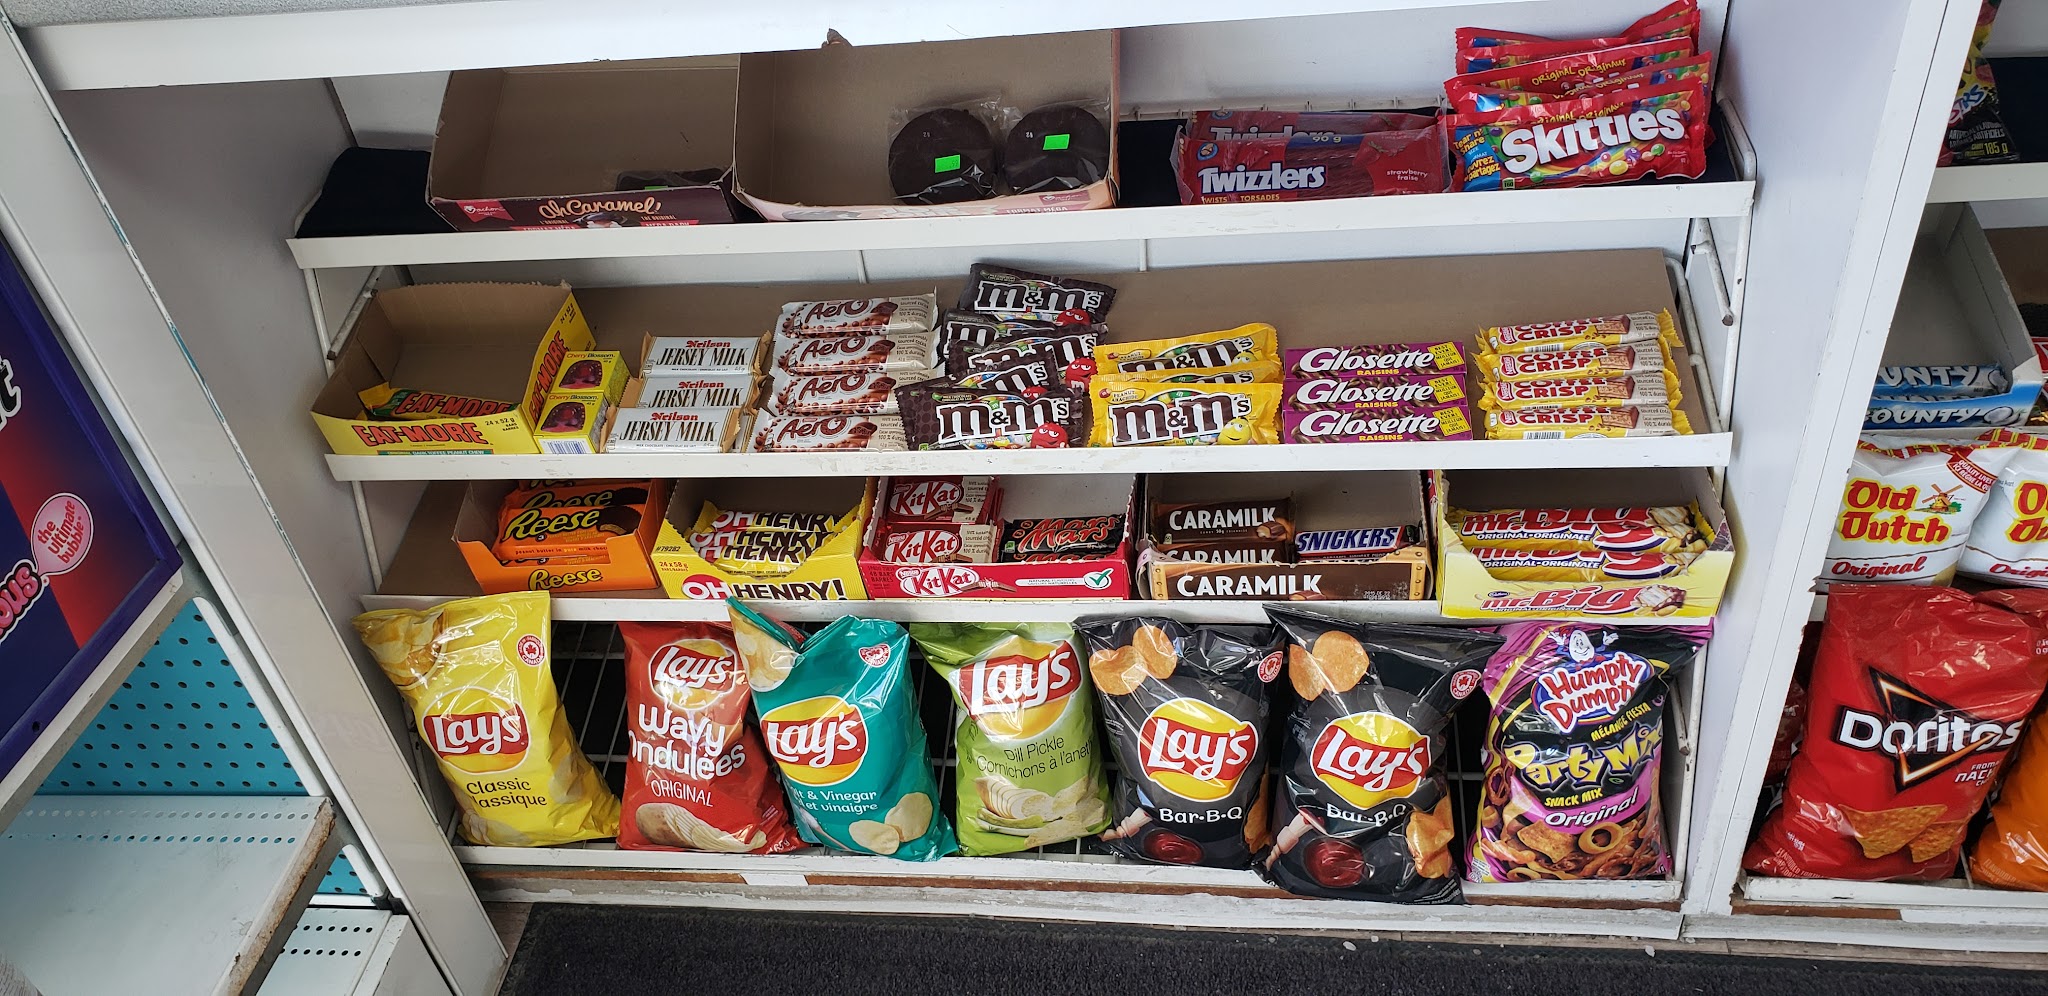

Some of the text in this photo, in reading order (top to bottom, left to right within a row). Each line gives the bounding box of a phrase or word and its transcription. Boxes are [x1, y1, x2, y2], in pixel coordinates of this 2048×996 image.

[1453, 134, 1471, 149] Tear
[1503, 108, 1686, 173] Skittles
[1198, 162, 1326, 193] Twizzlers
[1386, 169, 1428, 179] strawberry
[1397, 174, 1419, 182] fraise
[1468, 163, 1501, 181] partagez
[1240, 194, 1280, 202] TORSADES
[686, 340, 732, 348] Neilson
[1517, 326, 1588, 340] CRISP
[656, 348, 749, 366] JERSEY MILK
[1300, 347, 1435, 373] Glosette
[1519, 358, 1592, 373] CRISP
[678, 380, 725, 389] Neilson
[1297, 379, 1434, 405] Glosette
[1515, 386, 1589, 399] CRISP
[648, 388, 745, 408] JERSEY MILK
[650, 412, 699, 421] Neilson
[1112, 393, 1252, 445] m&m's
[1300, 411, 1440, 437] Glosette
[1518, 414, 1593, 424] CRISP
[352, 422, 490, 448] EAT-MORE
[619, 421, 719, 442] JERSEY MILK
[1958, 459, 1979, 477] QUALITY
[1978, 472, 1993, 485] LIVES
[1848, 481, 1918, 512] Old
[500, 509, 600, 543] Reese
[711, 511, 756, 528] OH
[1169, 507, 1277, 531] CARAMILK
[1841, 511, 1949, 543] Dutch
[37, 520, 56, 545] the
[57, 519, 84, 564] bubble
[1018, 523, 1109, 554] Mars
[1296, 527, 1399, 551] SNICKERS
[1831, 555, 1928, 579] Original
[530, 569, 602, 591] Reese
[682, 579, 849, 601] OH HENRY!
[1176, 574, 1323, 597] CARAMILK
[653, 645, 735, 687] Lay's
[1544, 654, 1643, 698] Humpty
[971, 647, 1074, 716] Lay's
[1543, 682, 1636, 730] Dumpt
[432, 707, 523, 756] Lay's
[637, 703, 726, 757] Wavy
[1591, 702, 1652, 743] MÉLANGE FIESTA
[1839, 709, 2023, 754] Doritos
[767, 711, 860, 769] Lay's
[1003, 735, 1065, 763] Dill Pickle
[1148, 719, 1251, 781] Lay's
[976, 755, 1046, 779] Cornichons
[1049, 756, 1058, 770] à
[1316, 728, 1426, 793] Lay's
[1503, 733, 1607, 789] Party
[466, 777, 532, 796] Classic
[651, 779, 714, 808] ORIGINAL
[807, 790, 877, 804] & Vinegar
[1544, 787, 1604, 808] SNACK MIX
[478, 792, 548, 809] lassique
[820, 803, 879, 815] vinaigre
[1545, 788, 1639, 827] Original
